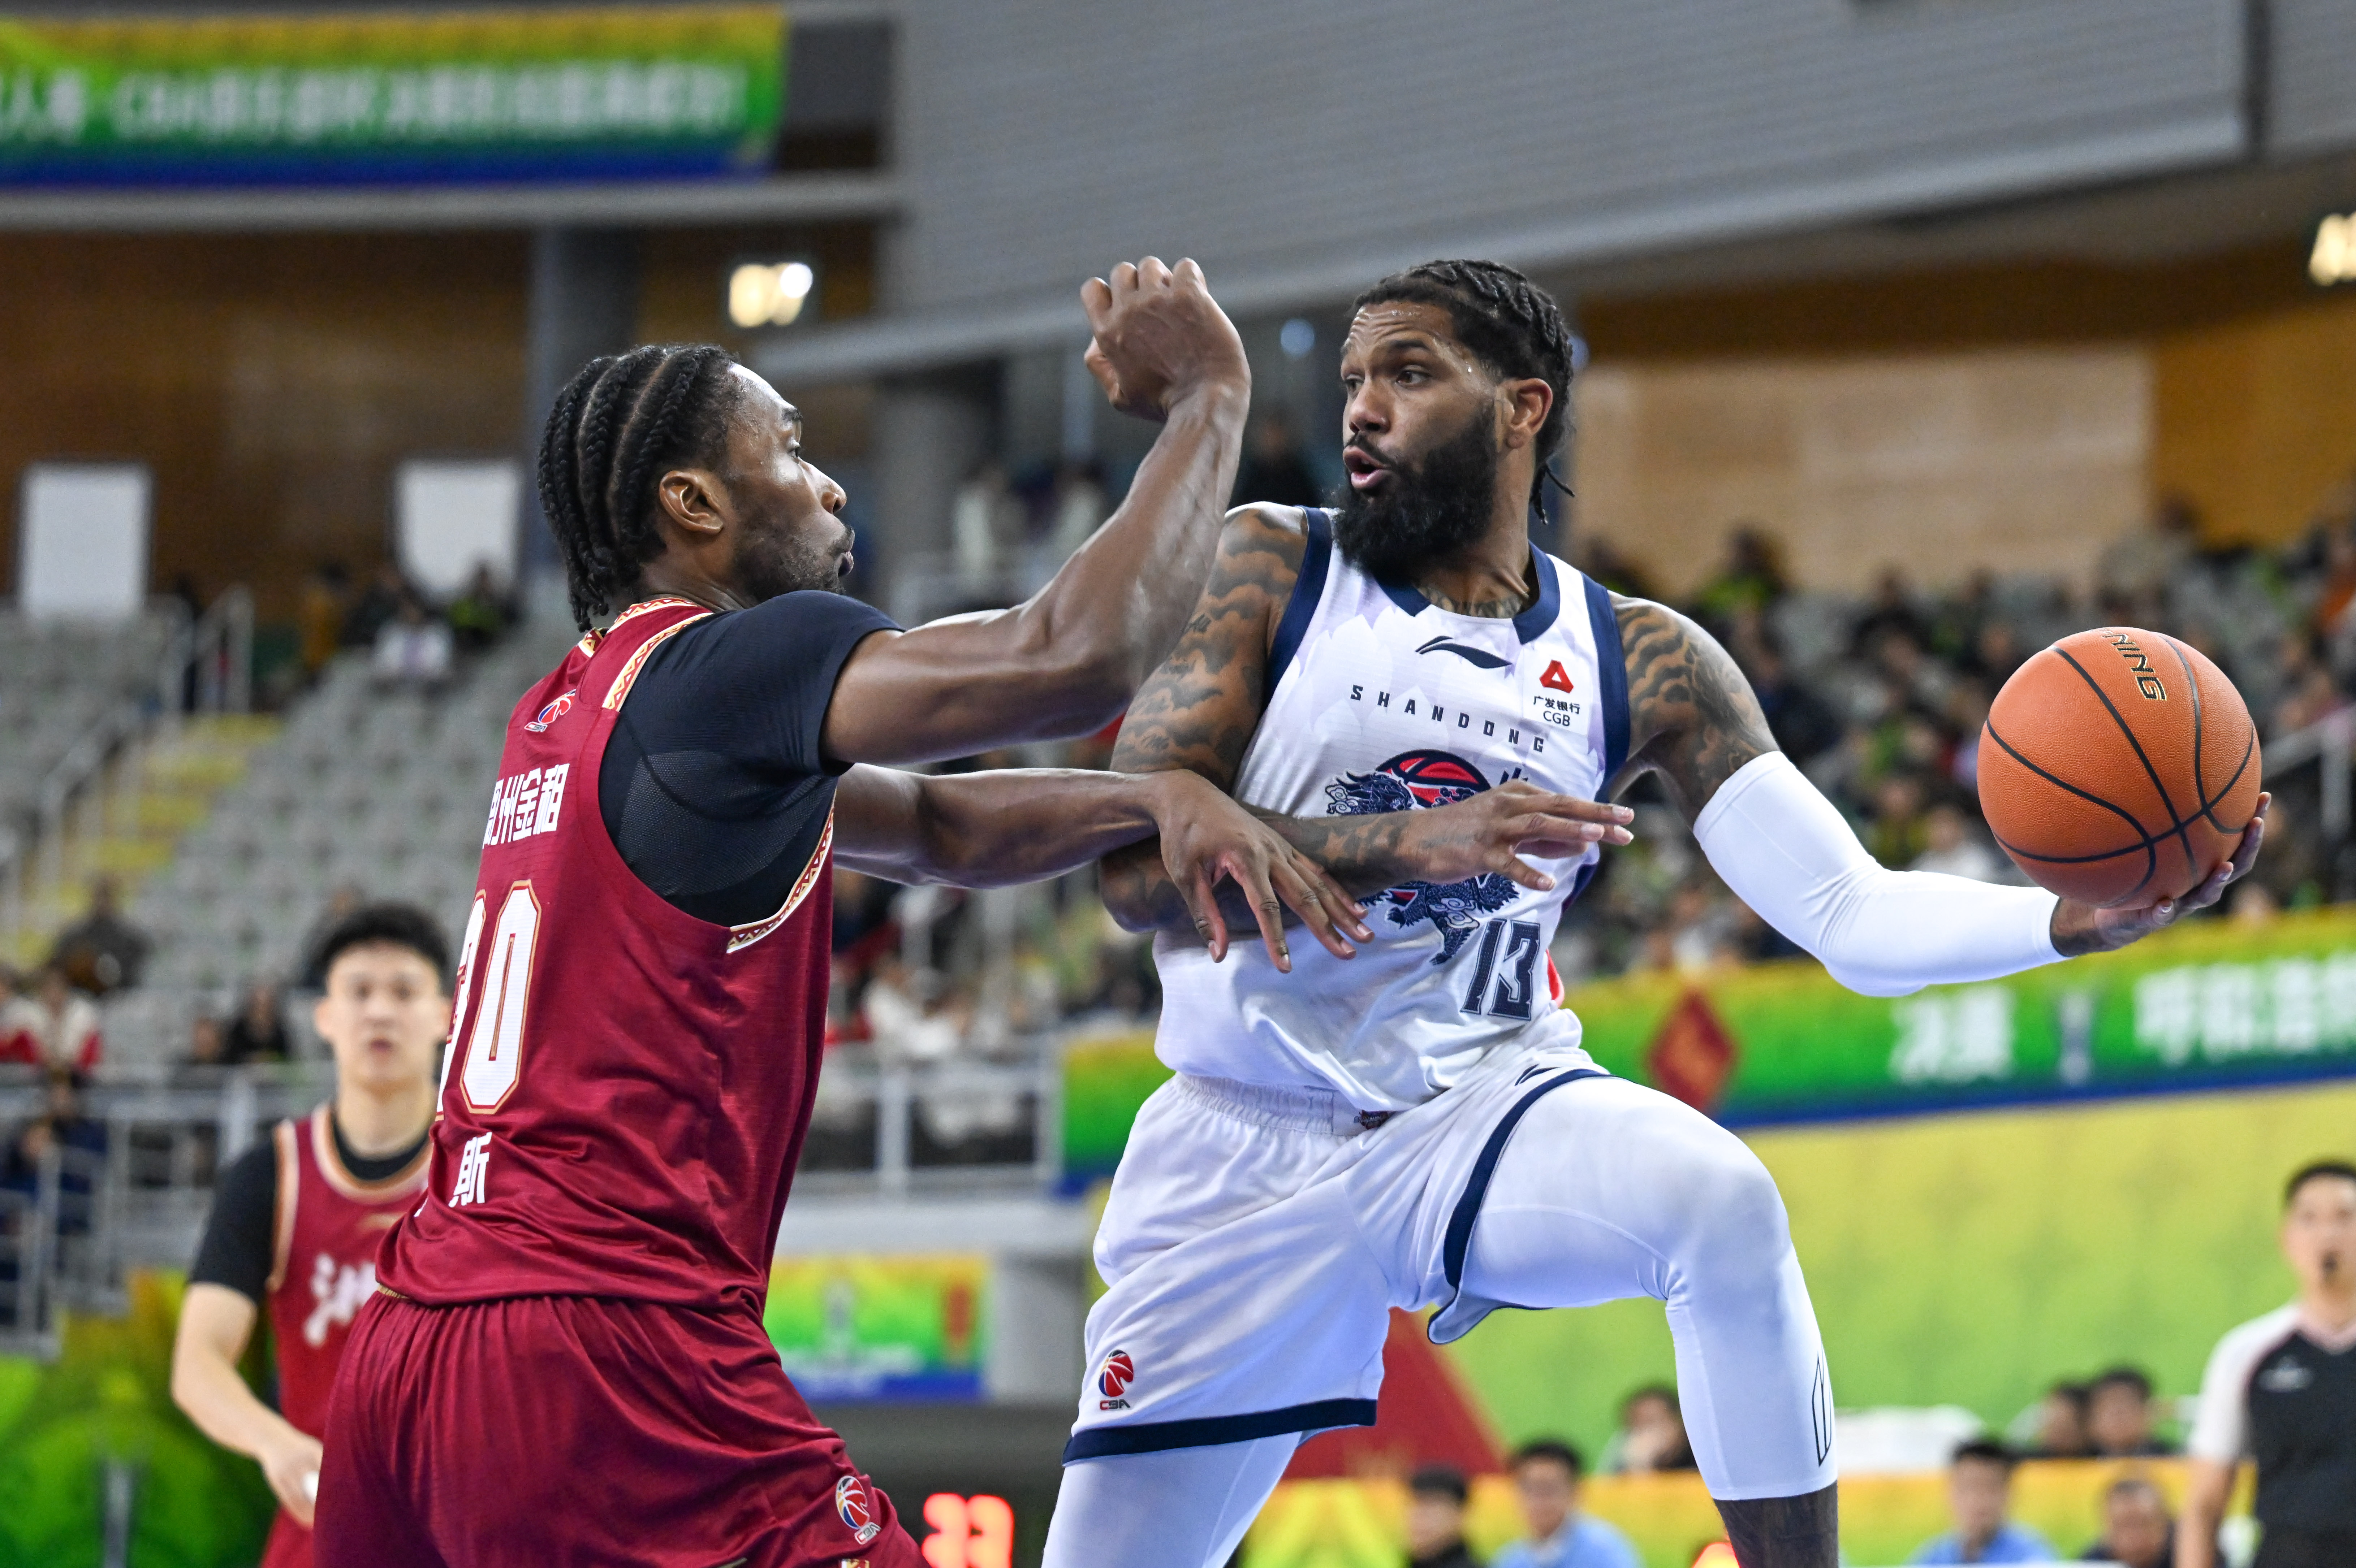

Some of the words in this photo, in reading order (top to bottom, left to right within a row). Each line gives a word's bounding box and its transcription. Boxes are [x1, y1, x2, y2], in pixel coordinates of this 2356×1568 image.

[1533, 696, 1580, 714] 广发银行
[1350, 685, 1544, 753] SHANDONG
[1543, 710, 1570, 727] CGB
[1459, 918, 1540, 1021] 13
[1099, 1399, 1131, 1410] CBA
[854, 1522, 881, 1545] CBA
